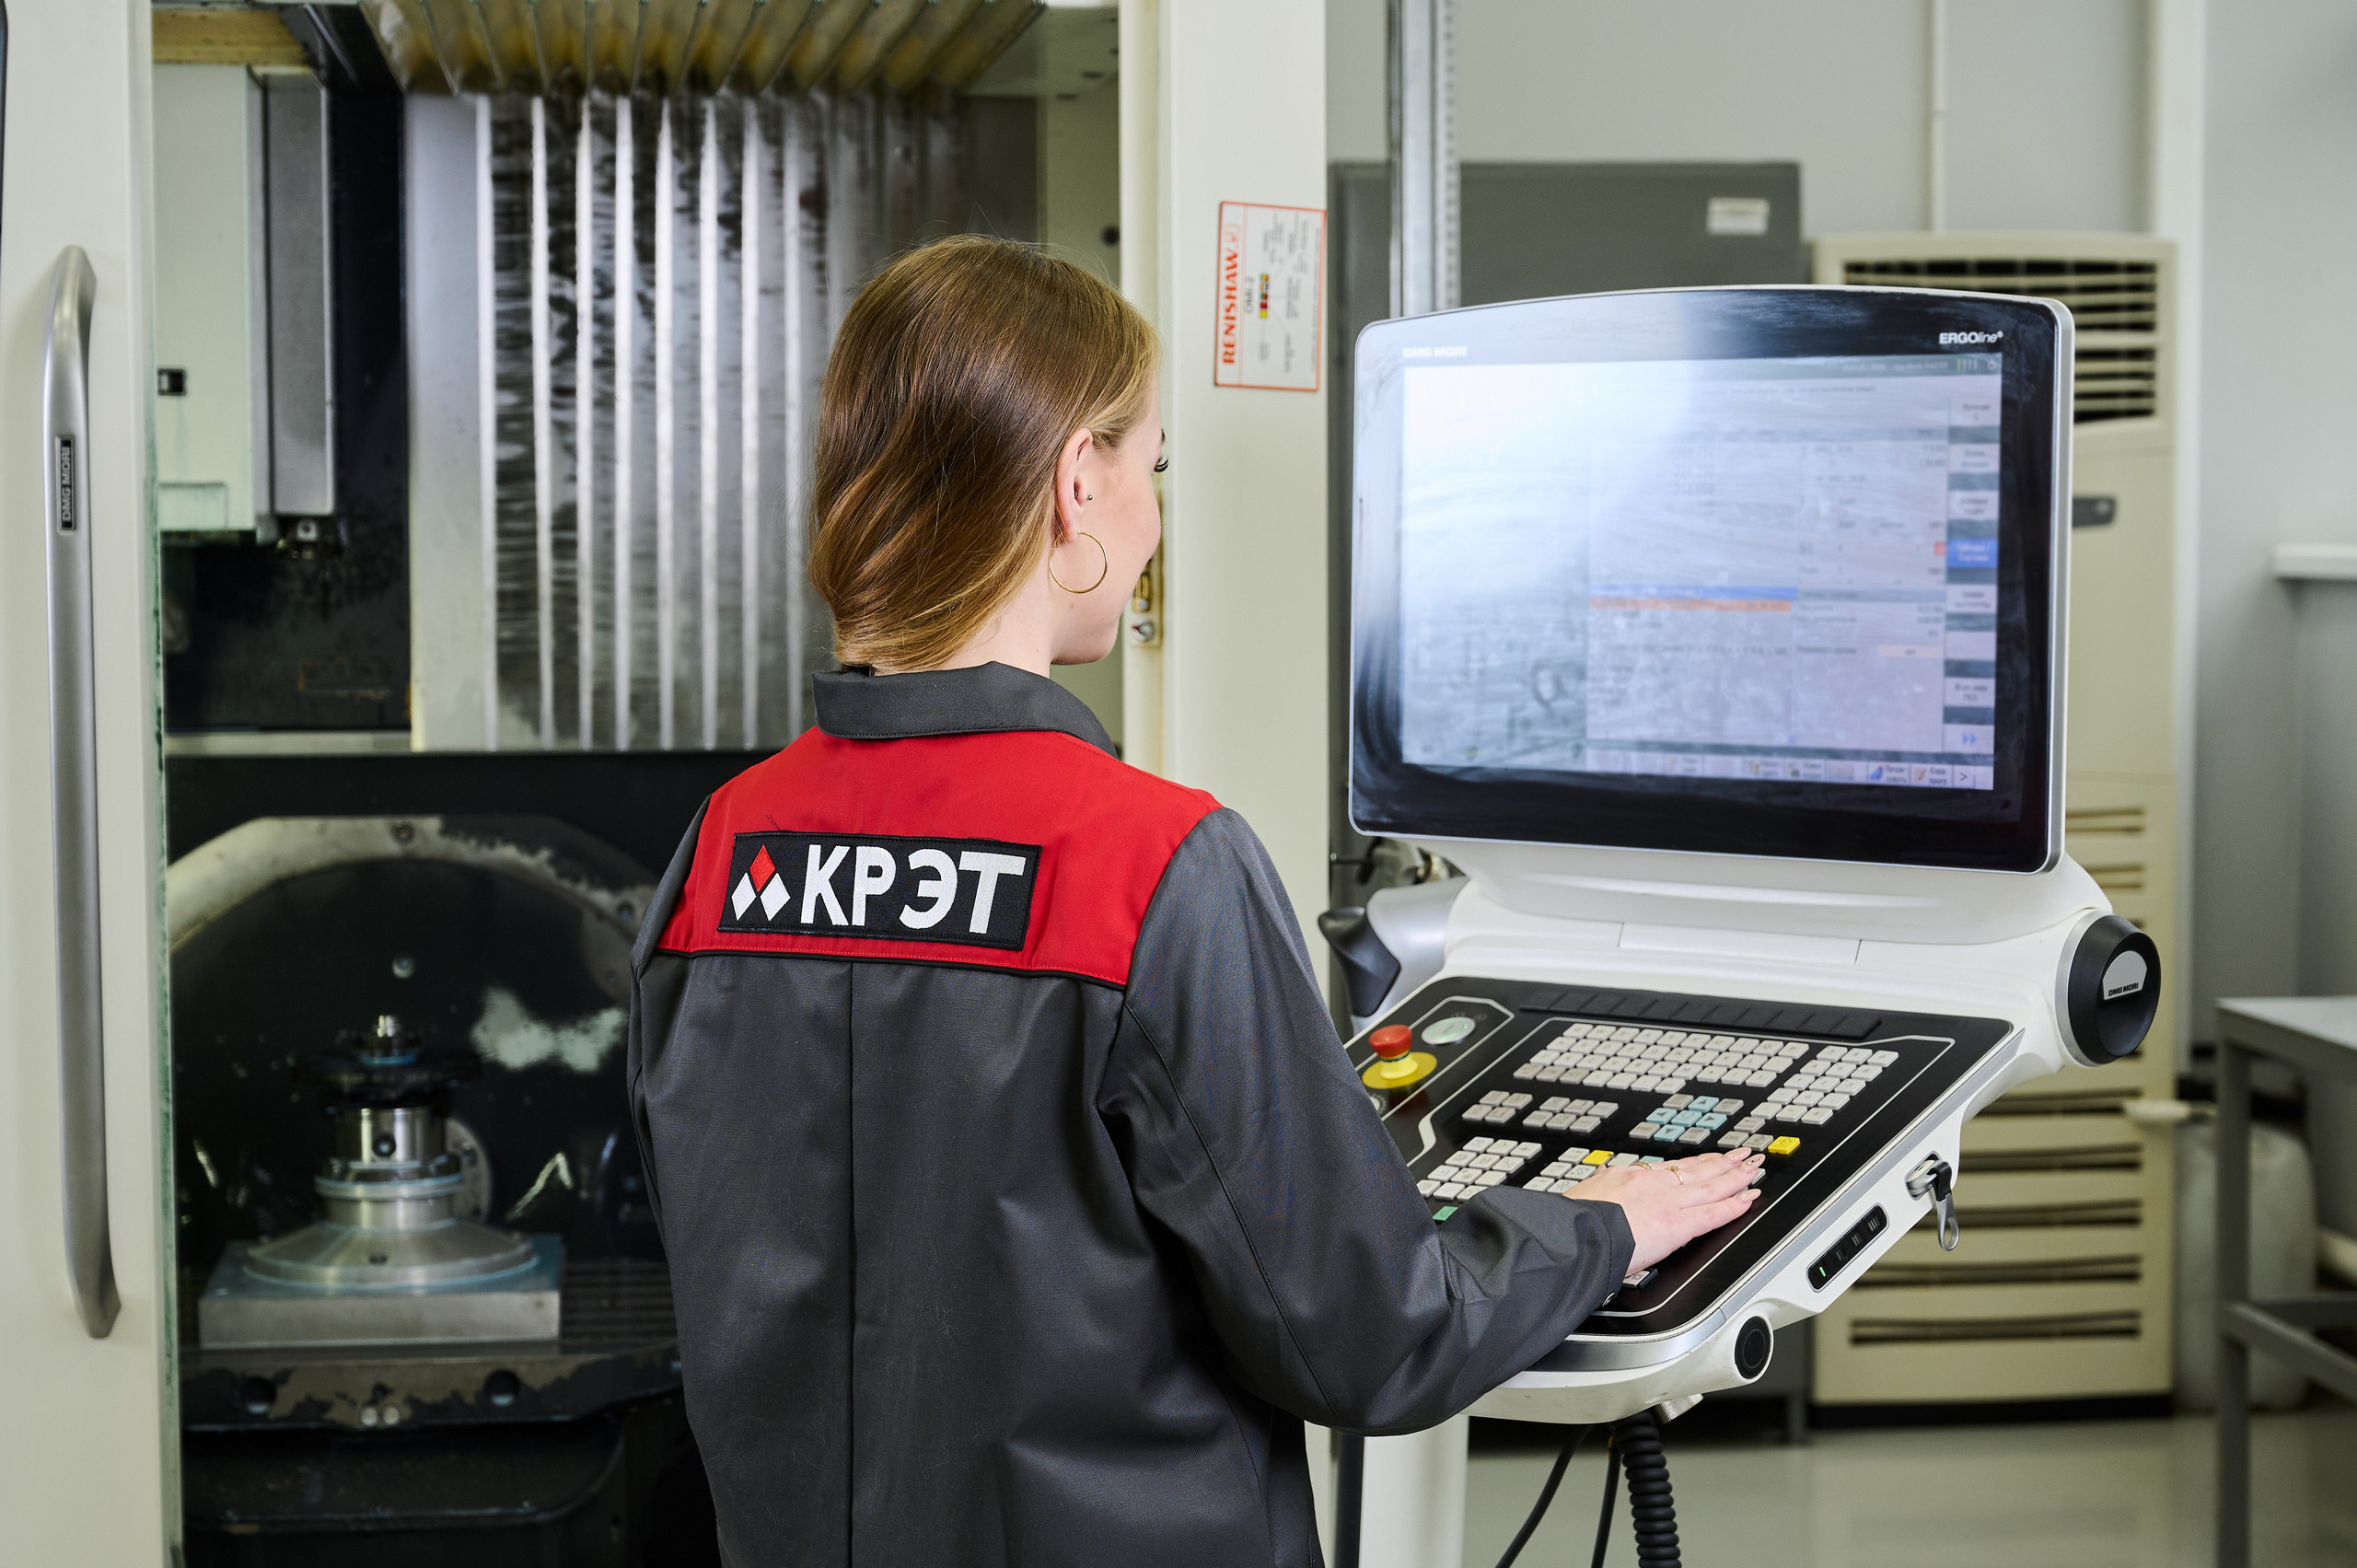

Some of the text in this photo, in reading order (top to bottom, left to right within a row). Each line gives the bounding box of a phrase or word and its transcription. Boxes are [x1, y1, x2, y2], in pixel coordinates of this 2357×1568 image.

[62, 447, 71, 521] DMG MORI
[801, 844, 1027, 935] КРЭТ
[2108, 982, 2139, 997] DMG MORI
